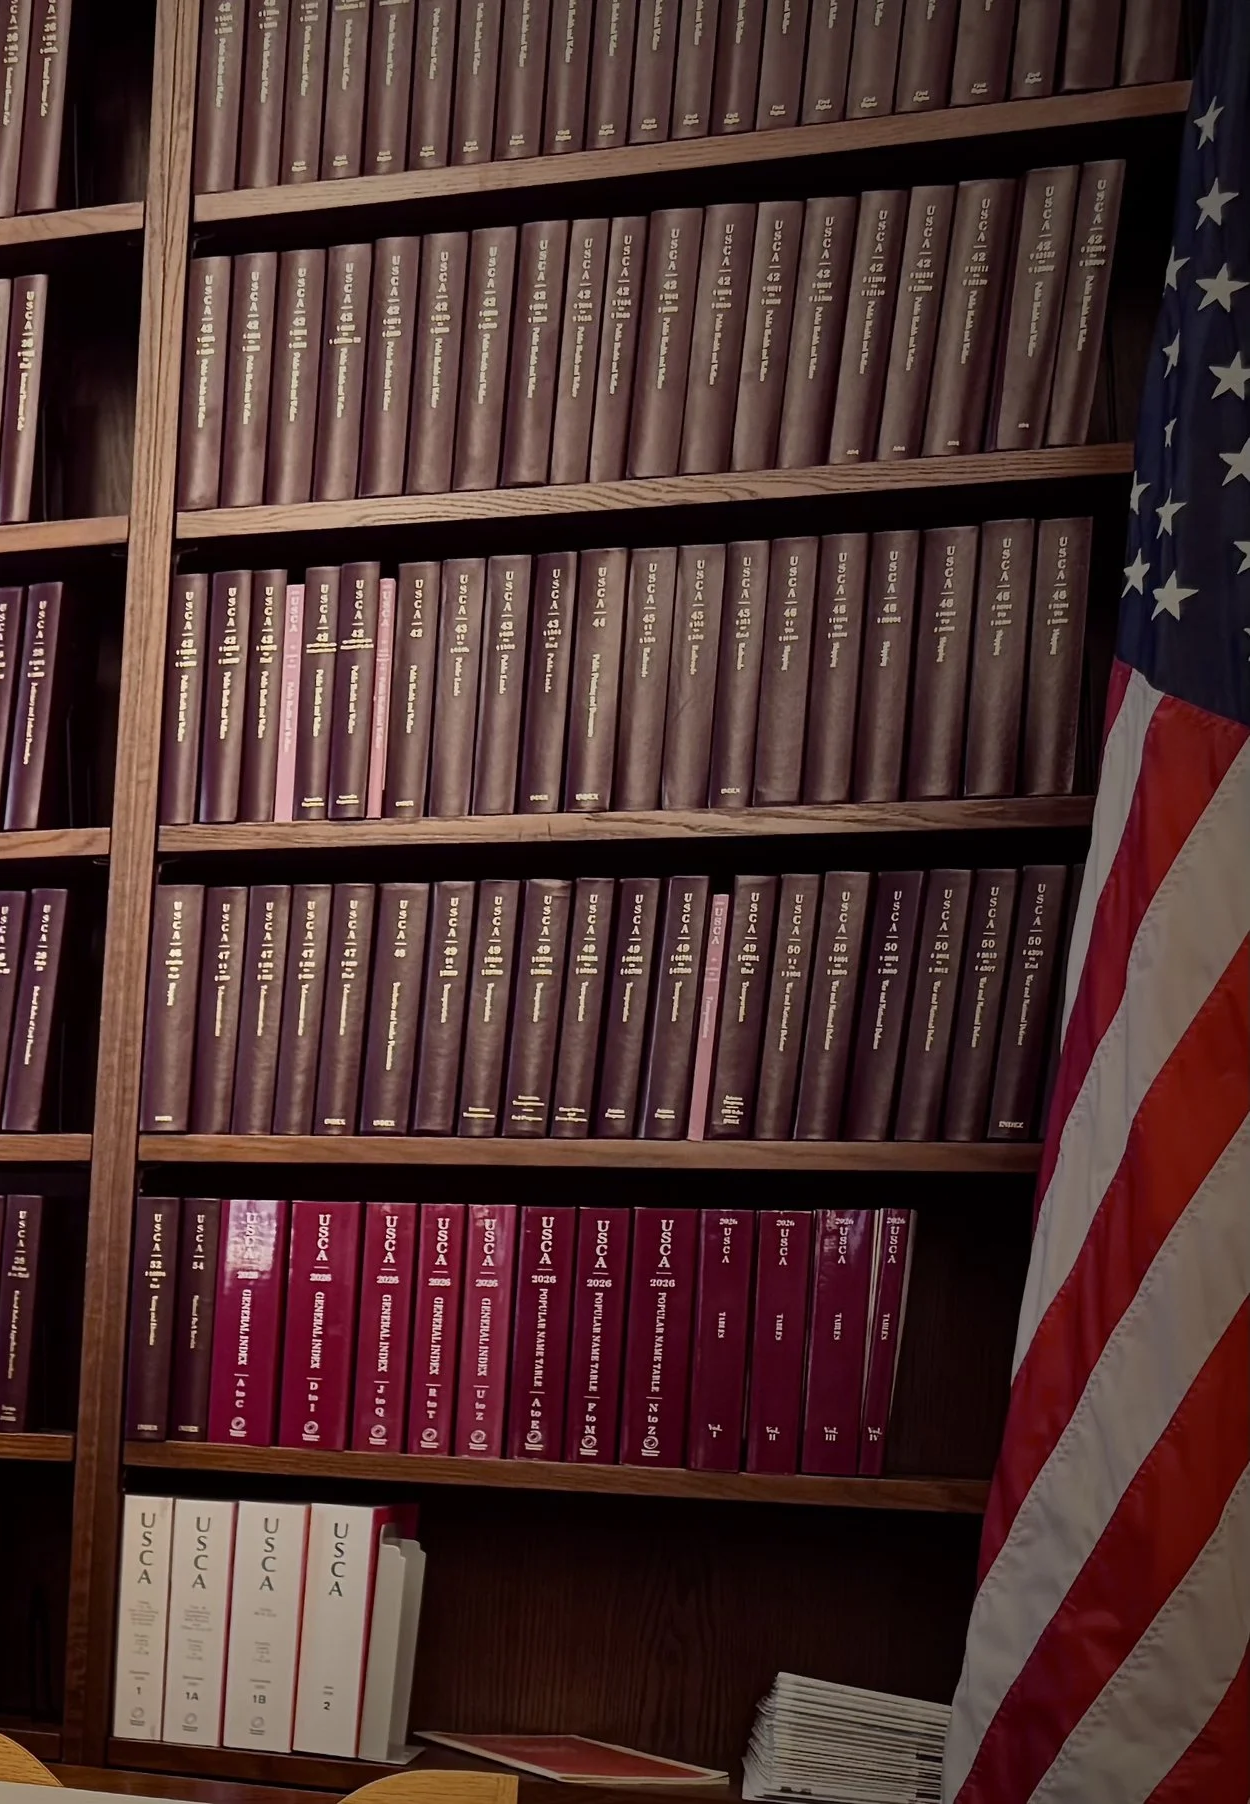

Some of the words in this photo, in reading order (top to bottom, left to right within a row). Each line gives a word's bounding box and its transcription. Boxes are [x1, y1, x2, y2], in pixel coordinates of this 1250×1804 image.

[1042, 186, 1054, 230] USCA
[1092, 178, 1108, 224] USCA
[874, 210, 888, 252] USCA
[922, 206, 936, 248] USCA
[978, 198, 990, 242] USCA
[1036, 240, 1052, 252] 42
[1088, 234, 1102, 244] 42
[870, 262, 884, 272] 42
[916, 258, 932, 268] 42
[972, 252, 986, 262] 42
[24, 291, 35, 330] USCA
[886, 550, 898, 594] USCA
[944, 546, 956, 588] USCA
[1000, 538, 1012, 582] USCA
[1056, 536, 1068, 580] USCA
[596, 566, 608, 608] USCA
[788, 556, 798, 598] USCA
[882, 604, 898, 614] 46
[938, 598, 954, 608] 46
[996, 592, 1010, 602] 46
[1052, 590, 1066, 602] 46
[36, 600, 46, 638] USCA
[784, 608, 798, 618] 46
[632, 894, 644, 934] USCA
[680, 892, 692, 934] USCA
[748, 892, 760, 934] USCA
[838, 892, 850, 934] USCA
[890, 890, 902, 932] USCA
[940, 890, 952, 930] USCA
[986, 886, 1000, 928] USCA
[1032, 884, 1046, 926] USCA
[40, 904, 52, 942] USCA
[628, 944, 640, 954] 49
[676, 944, 690, 952] 49
[742, 944, 756, 952] 49
[834, 942, 846, 952] 50
[884, 942, 898, 952] 50
[934, 942, 948, 950] 50
[982, 940, 996, 948] 50
[1028, 936, 1042, 946] 50
[152, 1214, 162, 1252] USCA
[196, 1214, 206, 1252] USCA
[316, 1214, 332, 1262] USCA
[382, 1216, 398, 1264] USCA
[434, 1218, 450, 1266] USCA
[482, 1219, 497, 1267] USCA
[540, 1216, 554, 1264] USCA
[594, 1220, 610, 1268] USCA
[658, 1220, 674, 1268] USCA
[722, 1227, 731, 1264] USCA
[778, 1229, 789, 1265] USCA
[838, 1227, 847, 1264] USCA
[888, 1227, 900, 1264] USCA
[532, 1274, 556, 1284] 2026
[586, 1278, 612, 1288] 2026
[650, 1278, 676, 1288] 2026
[240, 1288, 252, 1334] GENERAL
[312, 1292, 324, 1338] GENERAL
[380, 1294, 392, 1340] GENERAL
[432, 1296, 444, 1344] GENERAL
[478, 1298, 492, 1344] GENERAL
[536, 1288, 548, 1328] POPULAR
[592, 1292, 604, 1334] POPULAR
[656, 1292, 666, 1334] POPULAR
[238, 1336, 250, 1366] INDEX
[310, 1338, 322, 1368] INDEX
[378, 1342, 390, 1372] INDEX
[536, 1330, 546, 1356] NAME
[590, 1334, 600, 1362] NAME
[654, 1336, 664, 1362] NAME
[430, 1344, 442, 1374] INDEX
[478, 1346, 490, 1376] INDEX
[534, 1358, 544, 1386] TABLE
[236, 1378, 246, 1386] A
[310, 1382, 318, 1390] D
[376, 1384, 384, 1394] J
[428, 1388, 436, 1396] R
[588, 1362, 598, 1392] TABLE
[650, 1362, 662, 1392] TABLE
[236, 1390, 246, 1398] to
[236, 1400, 244, 1408] C
[310, 1404, 316, 1412] I
[426, 1400, 438, 1408] to
[474, 1402, 486, 1410] to
[476, 1390, 486, 1398] U
[532, 1398, 542, 1408] A
[588, 1402, 596, 1412] F
[648, 1404, 658, 1412] N
[374, 1408, 384, 1418] Q
[426, 1410, 436, 1418] T
[476, 1412, 484, 1420] Z
[530, 1410, 542, 1418] to
[530, 1420, 540, 1430] E
[586, 1414, 596, 1422] to
[648, 1414, 658, 1422] to
[584, 1424, 596, 1434] M
[648, 1426, 656, 1434] Z
[138, 1512, 156, 1584] USCA
[192, 1516, 210, 1590] USCA
[258, 1518, 280, 1592] USCA
[328, 1522, 348, 1598] USCA
[136, 1686, 142, 1694] 1
[186, 1692, 198, 1700] 1A
[252, 1694, 266, 1704] 1B
[324, 1702, 330, 1710] 2
